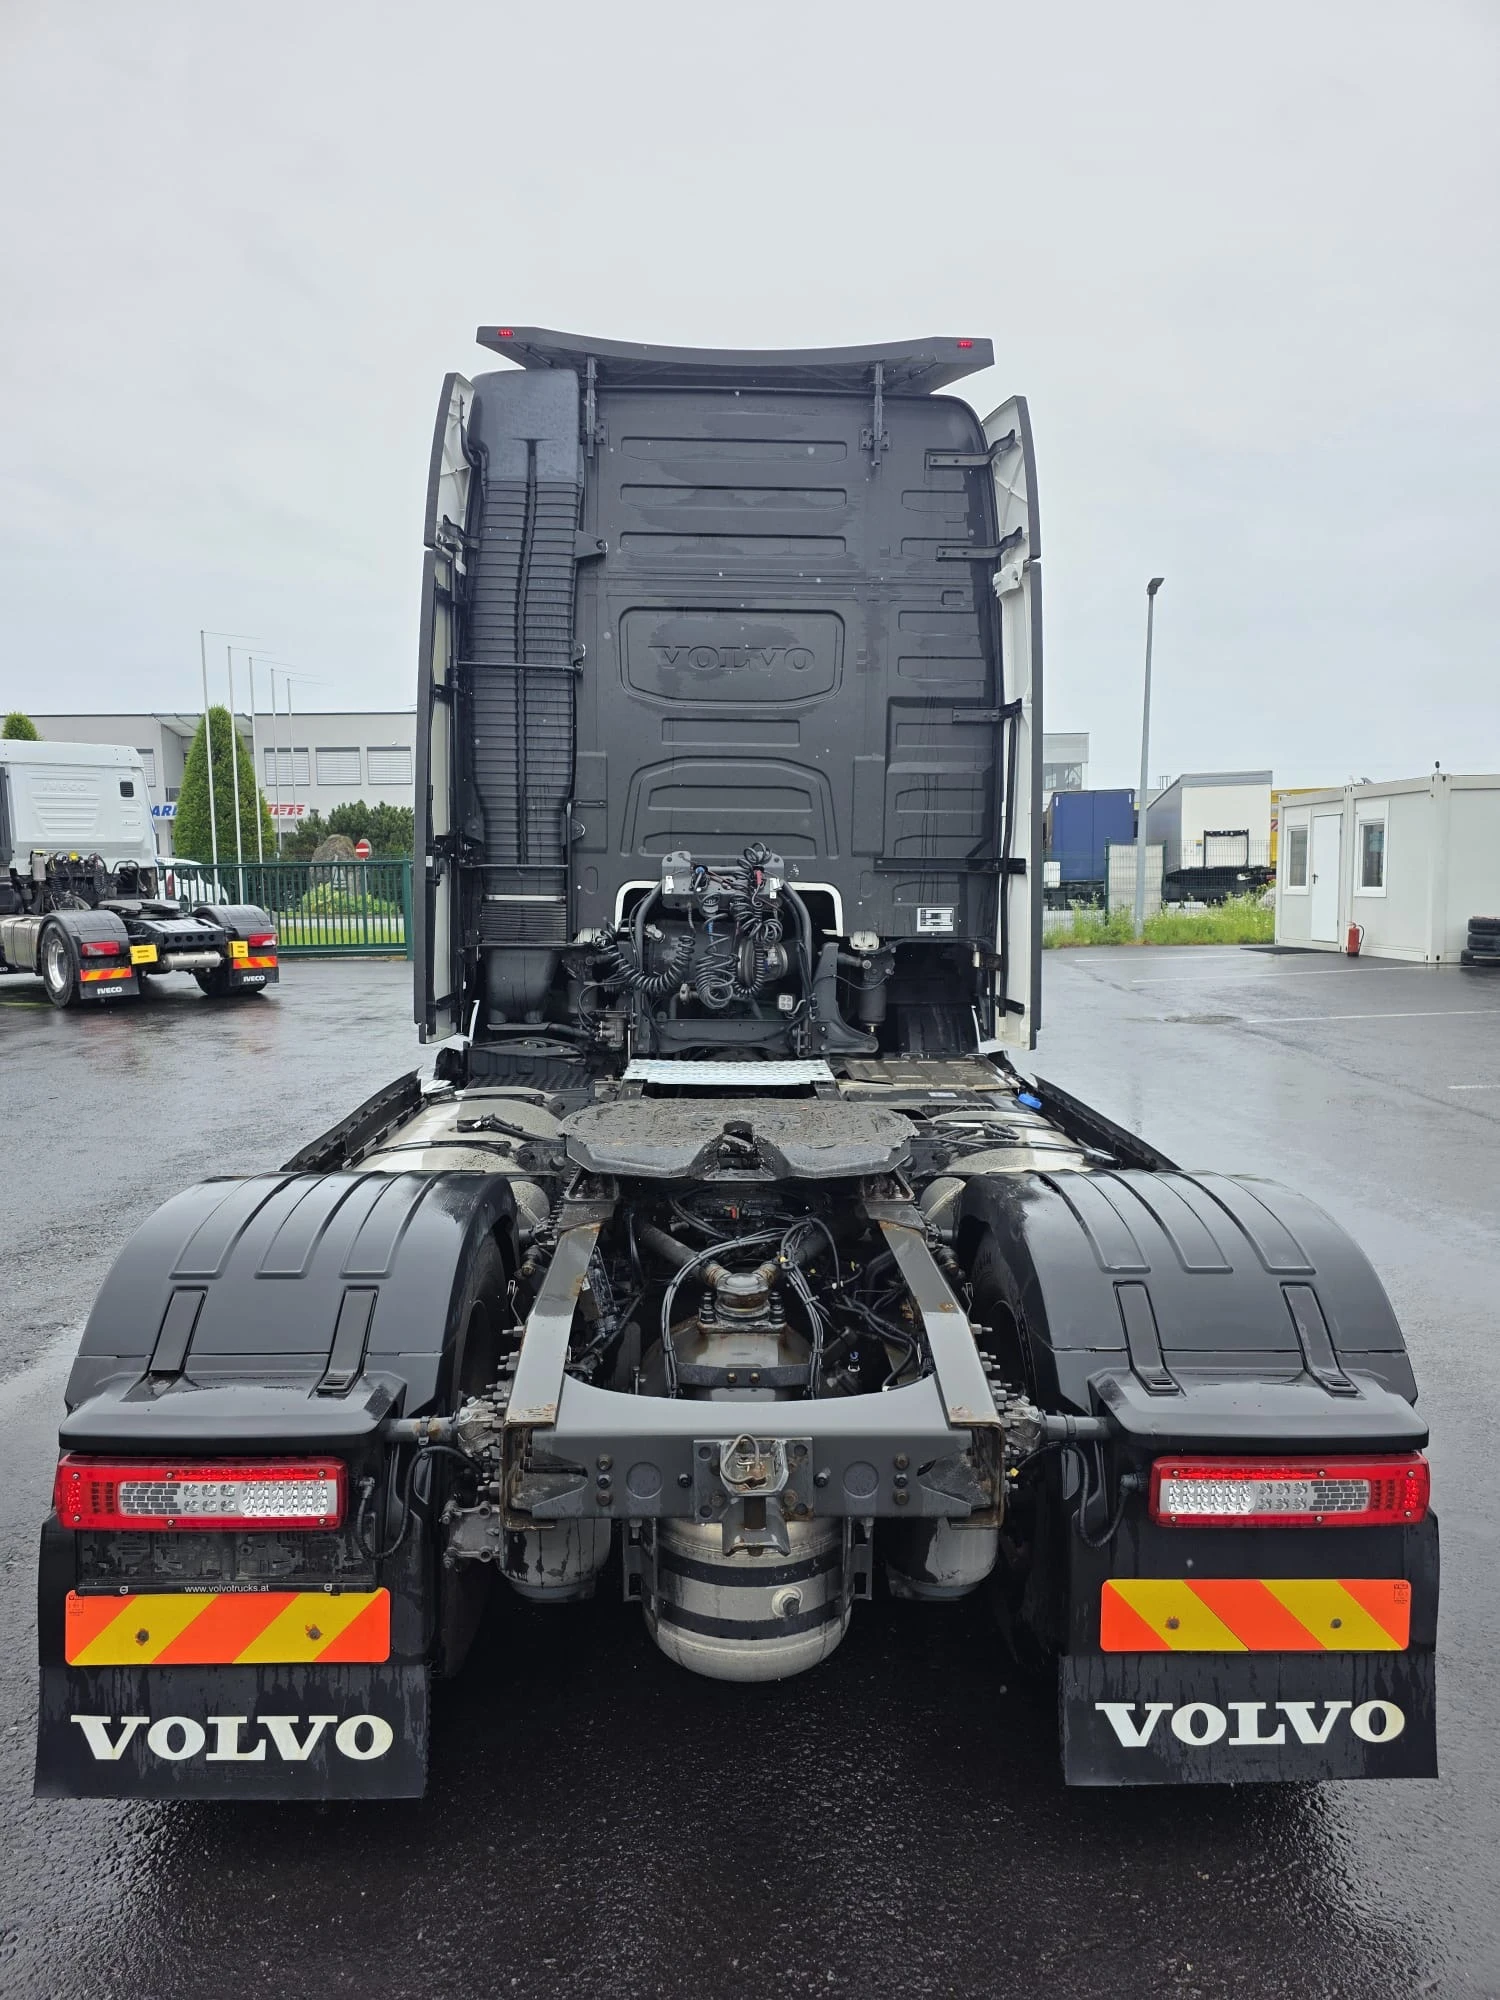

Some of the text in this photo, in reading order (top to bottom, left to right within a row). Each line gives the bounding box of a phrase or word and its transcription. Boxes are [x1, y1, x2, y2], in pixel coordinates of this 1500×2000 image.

[648, 646, 816, 671] VOLVO
[243, 975, 265, 983] IVECO
[97, 986, 122, 995] IVECO
[185, 1585, 269, 1593] www.volvotrucks.at
[1095, 1700, 1405, 1748] VOLVO
[70, 1715, 394, 1761] VOLVO
